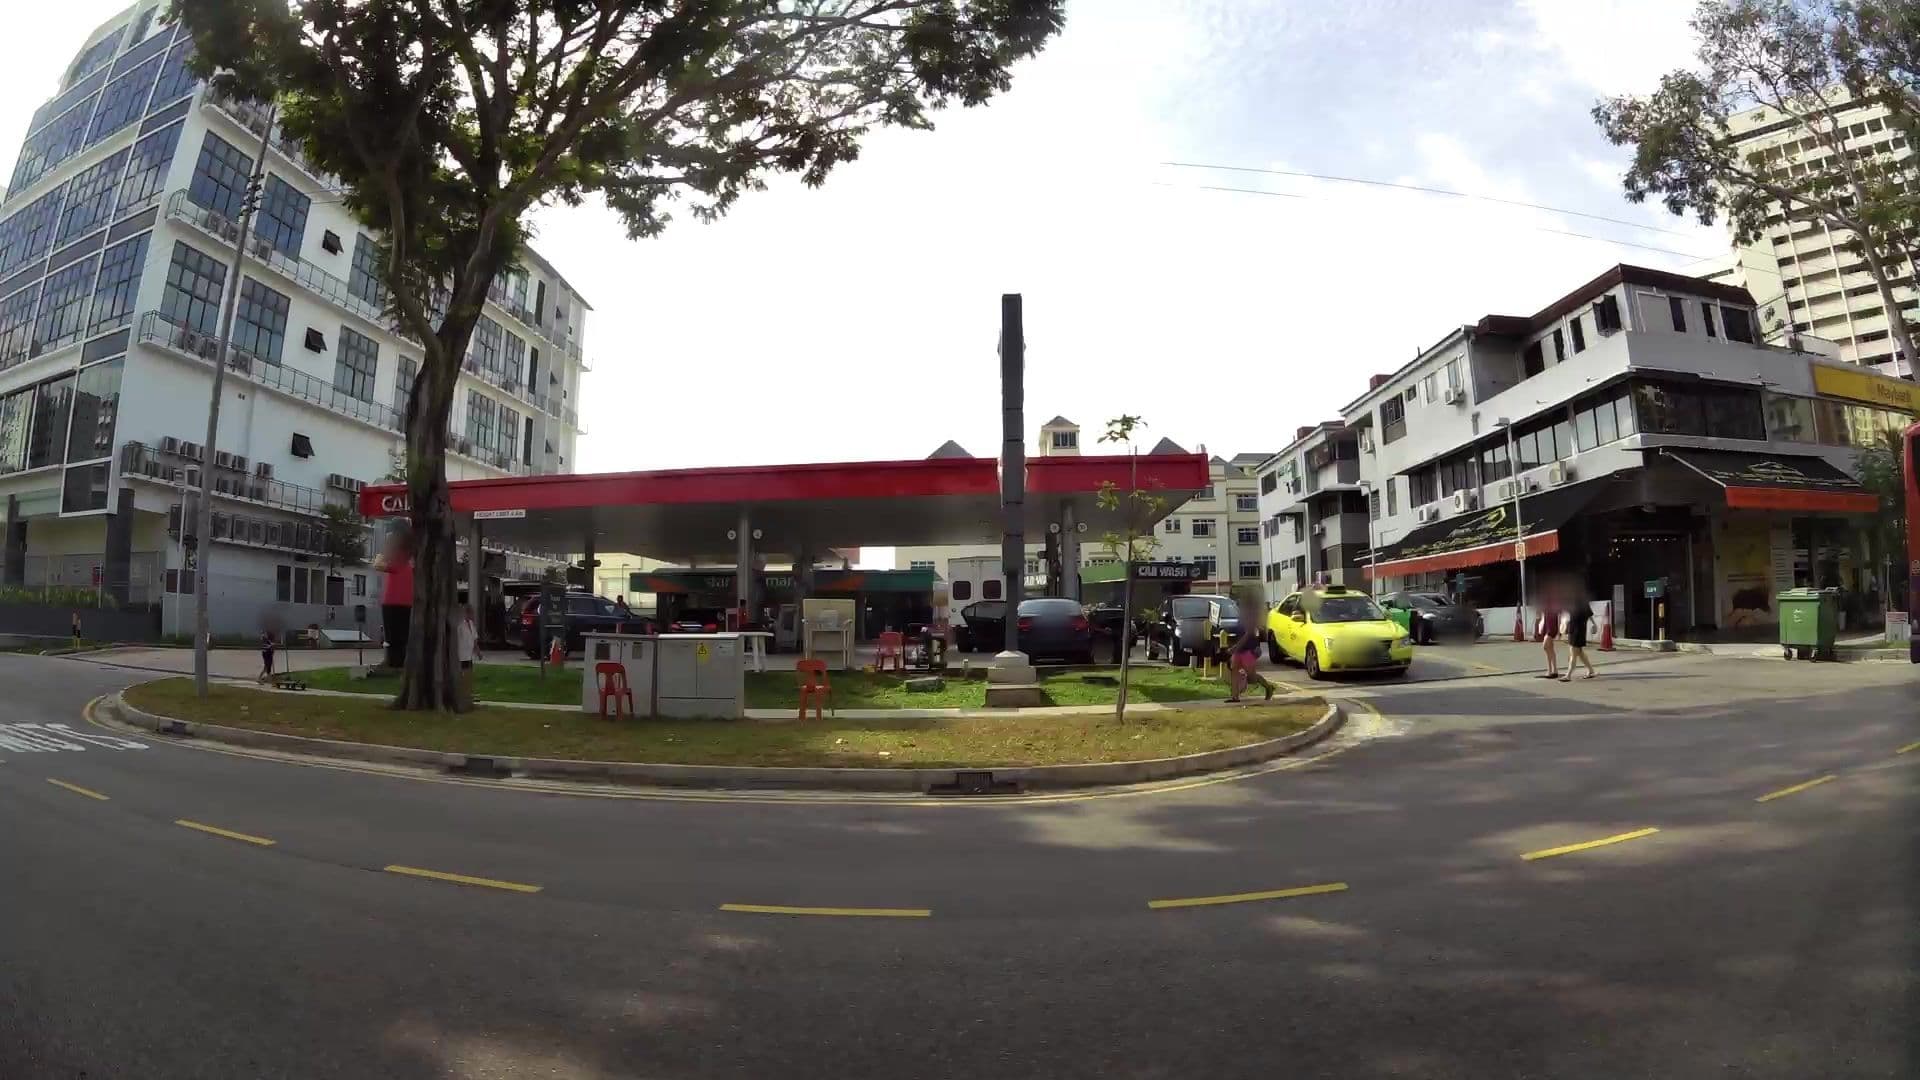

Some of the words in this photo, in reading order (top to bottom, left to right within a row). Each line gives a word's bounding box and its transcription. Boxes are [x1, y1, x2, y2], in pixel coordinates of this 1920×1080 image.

[1877, 383, 1912, 402] Maybank
[382, 494, 411, 512] CAL
[1138, 566, 1157, 577] CAR
[1159, 566, 1187, 577] WASH
